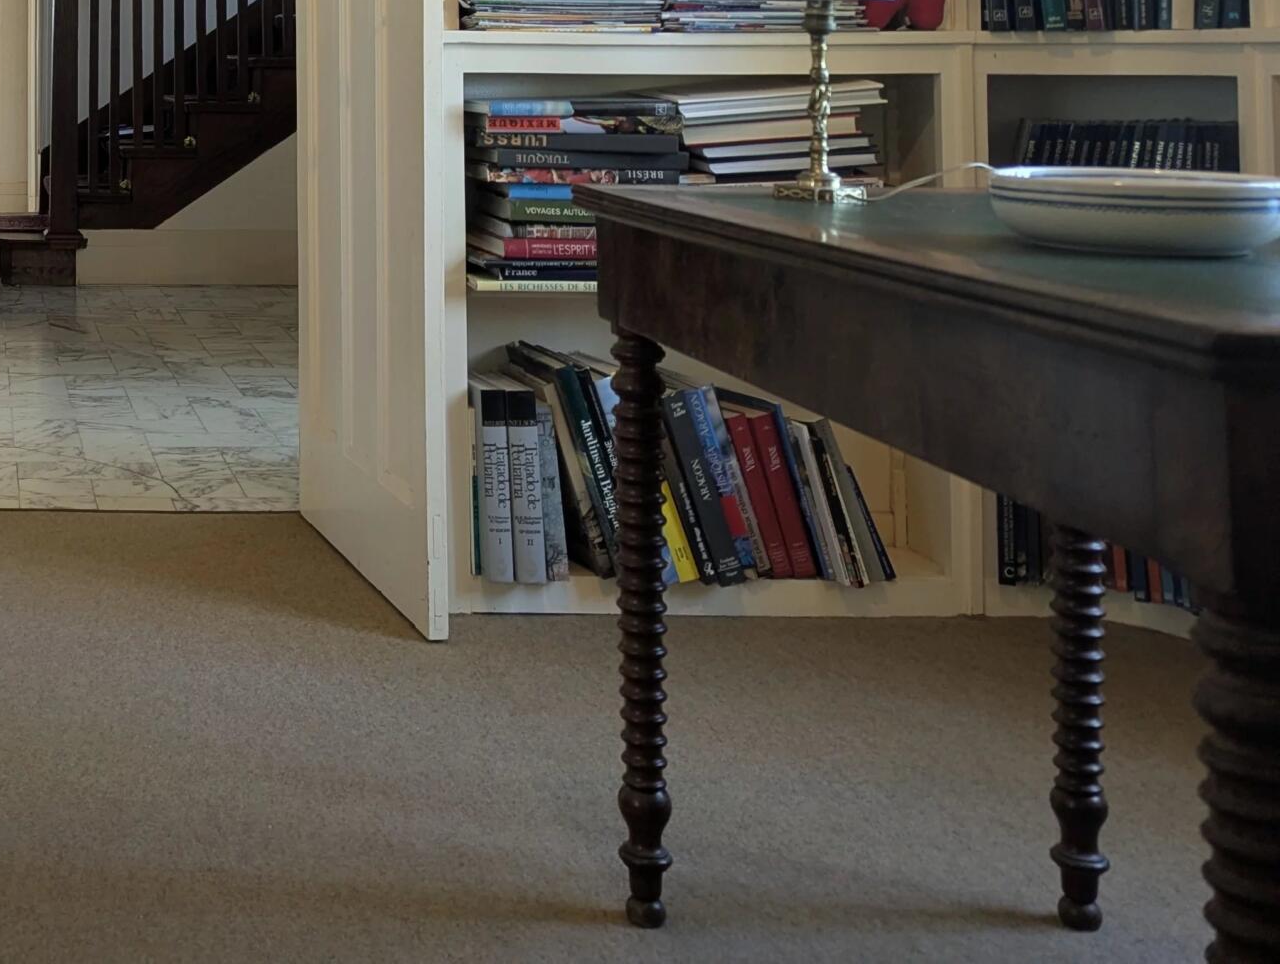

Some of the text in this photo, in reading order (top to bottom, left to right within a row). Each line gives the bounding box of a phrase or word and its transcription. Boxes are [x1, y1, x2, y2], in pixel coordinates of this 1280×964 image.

[488, 119, 557, 129] MEXIQUE
[516, 154, 570, 164] TURQUIE
[525, 206, 593, 216] VOYAGES AUTO
[553, 243, 590, 256] L'ESPRIT
[518, 283, 563, 291] RICHESSES
[689, 394, 713, 441] ARAGON
[580, 419, 602, 465] Jardins
[496, 446, 510, 492] Tratado
[524, 442, 539, 492] Tratado
[691, 459, 712, 501] ARAGON
[498, 492, 511, 509] de
[527, 493, 540, 510] de
